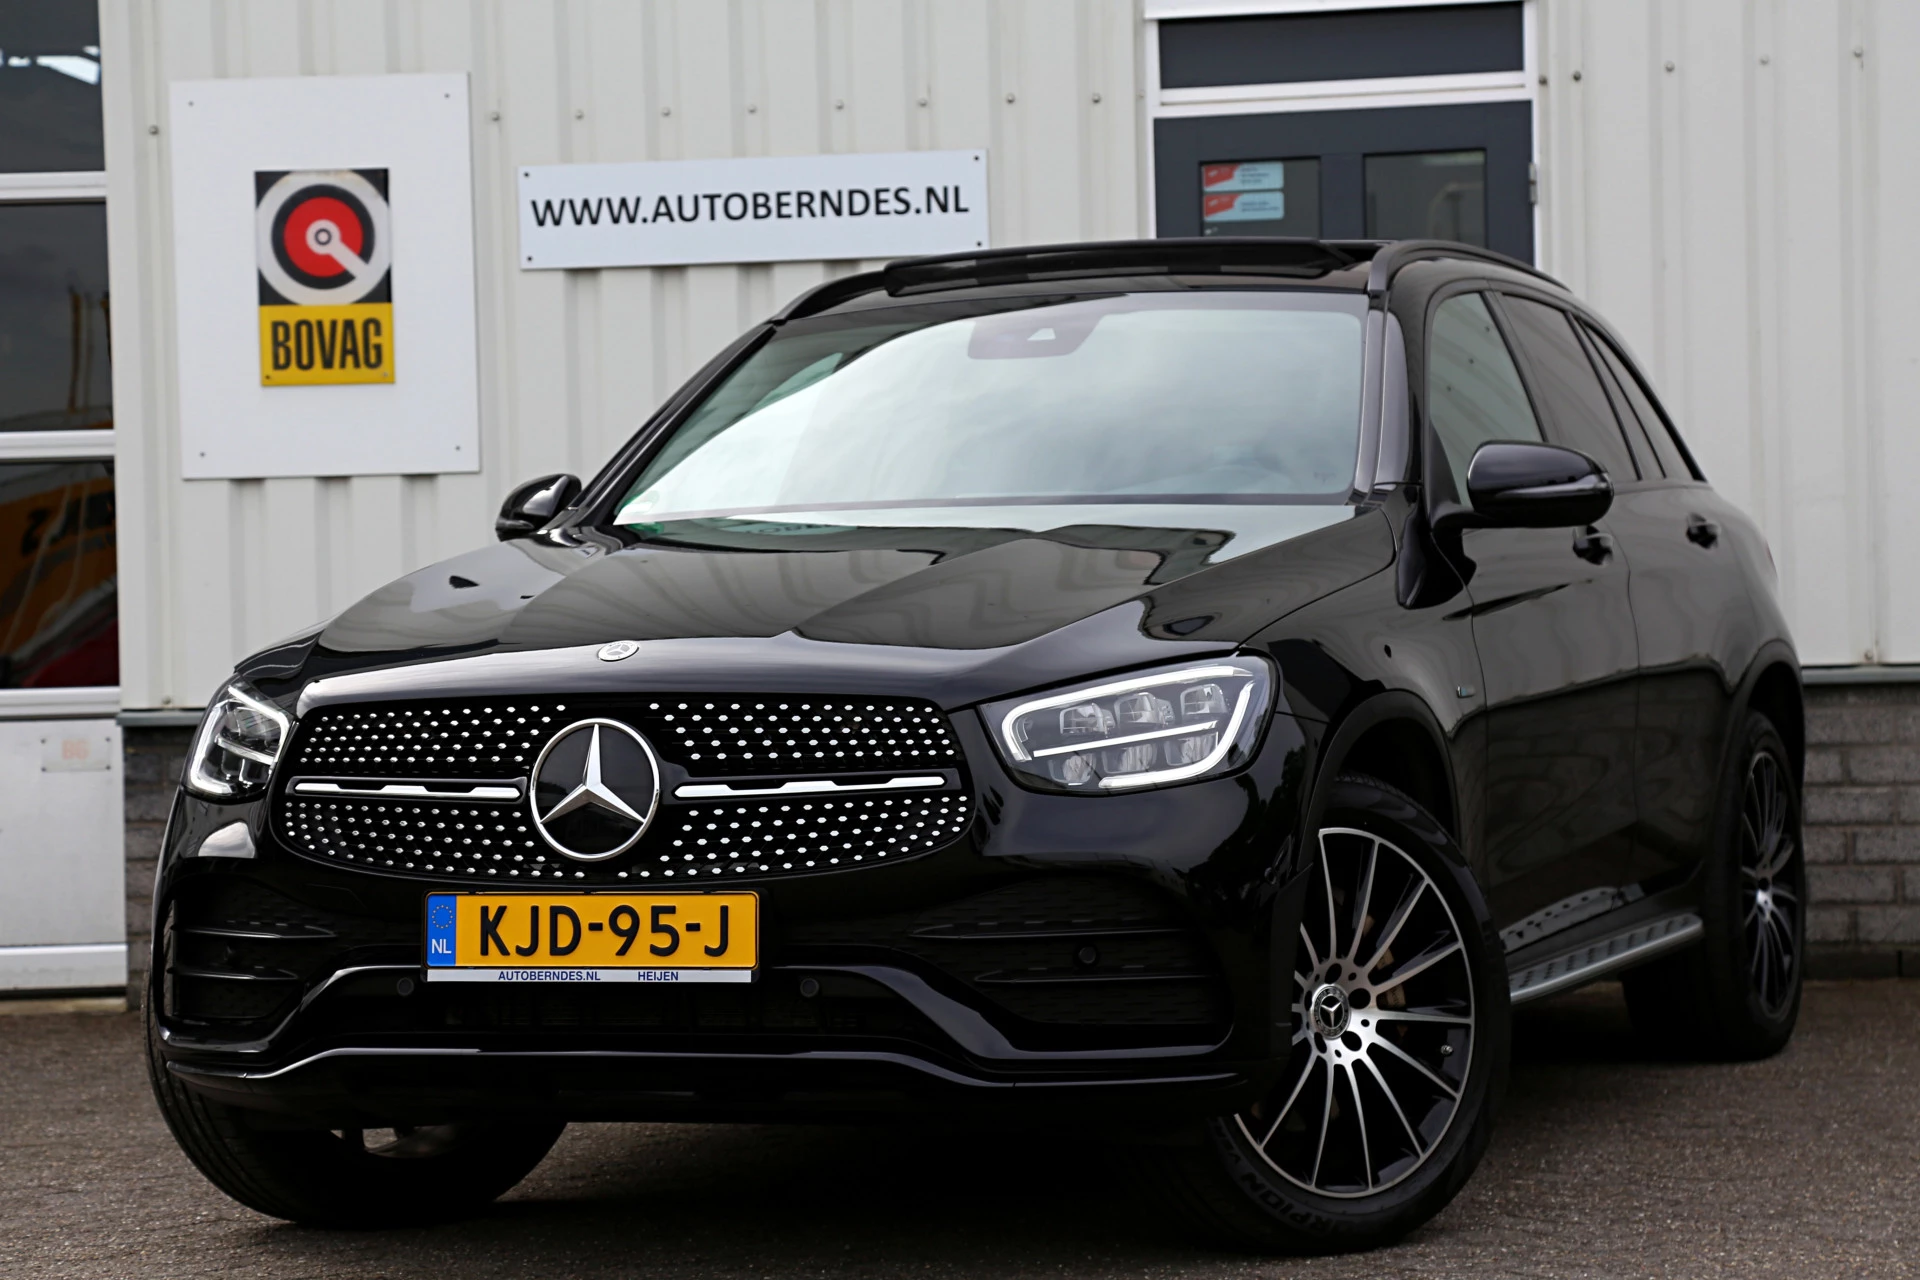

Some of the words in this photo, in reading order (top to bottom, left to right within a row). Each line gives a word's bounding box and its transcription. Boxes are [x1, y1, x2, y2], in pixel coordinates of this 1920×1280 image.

[531, 185, 968, 227] WWW.AUTOBERNDES.NL
[271, 317, 383, 371] BOVAG
[431, 939, 451, 954] NL
[480, 904, 729, 957] KJD-95-J
[498, 971, 600, 982] AUTOBERNDES.NL
[638, 971, 679, 982] HEIJEN
